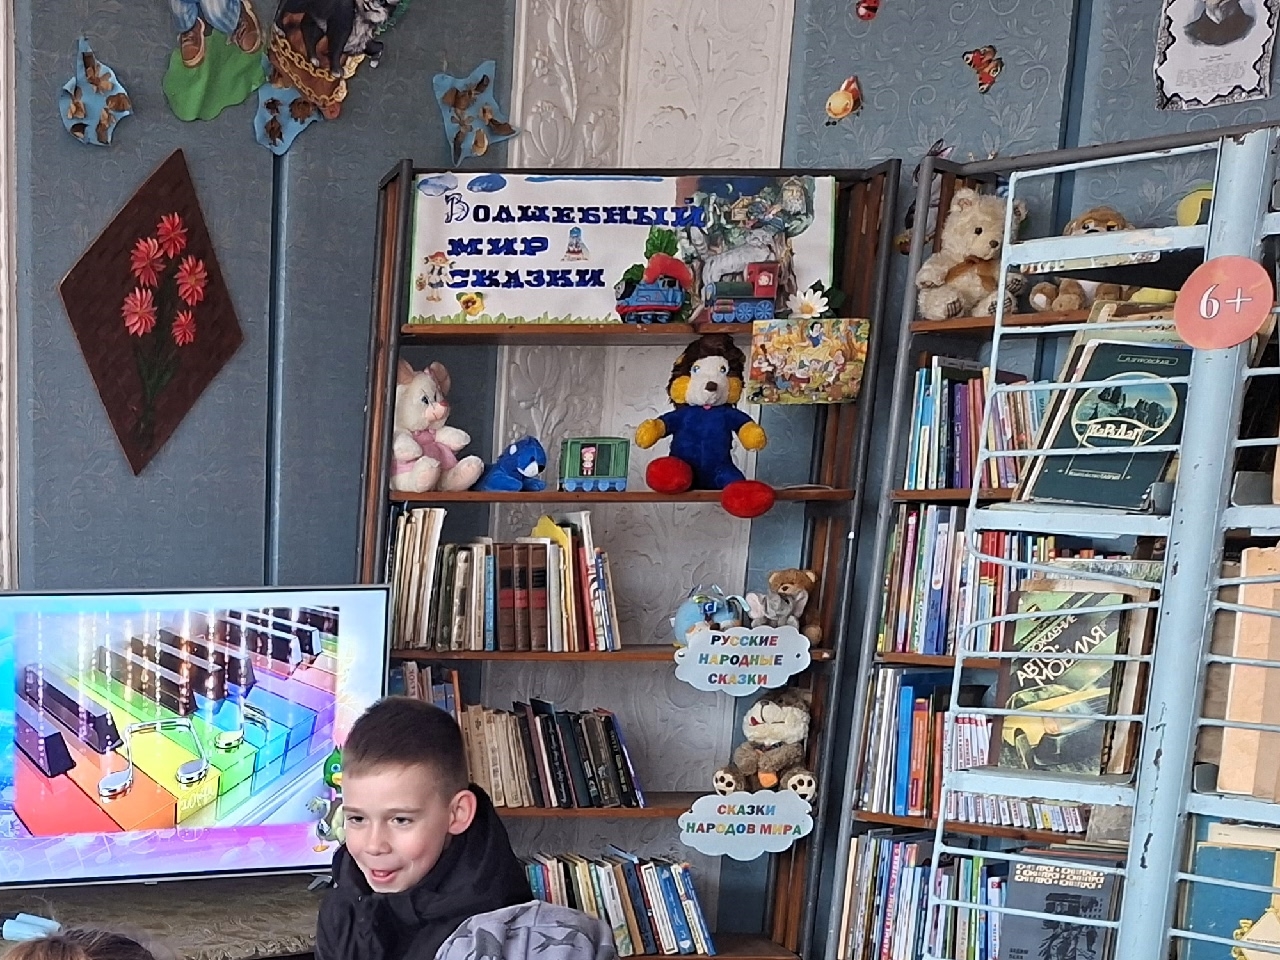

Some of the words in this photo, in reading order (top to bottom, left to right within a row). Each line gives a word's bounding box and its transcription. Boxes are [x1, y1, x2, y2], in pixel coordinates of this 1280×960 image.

[447, 237, 550, 256] МИР
[446, 268, 606, 289] СКАЗКИ
[1198, 283, 1252, 320] 6+
[710, 635, 779, 647] РУССКИЕ
[698, 652, 784, 667] НАРОДНЫЕ
[707, 673, 768, 685] СКАЗКИ
[716, 804, 776, 816] СКАЗКИ
[686, 822, 756, 836] НАРОДОВ
[759, 823, 802, 836] МИРА
